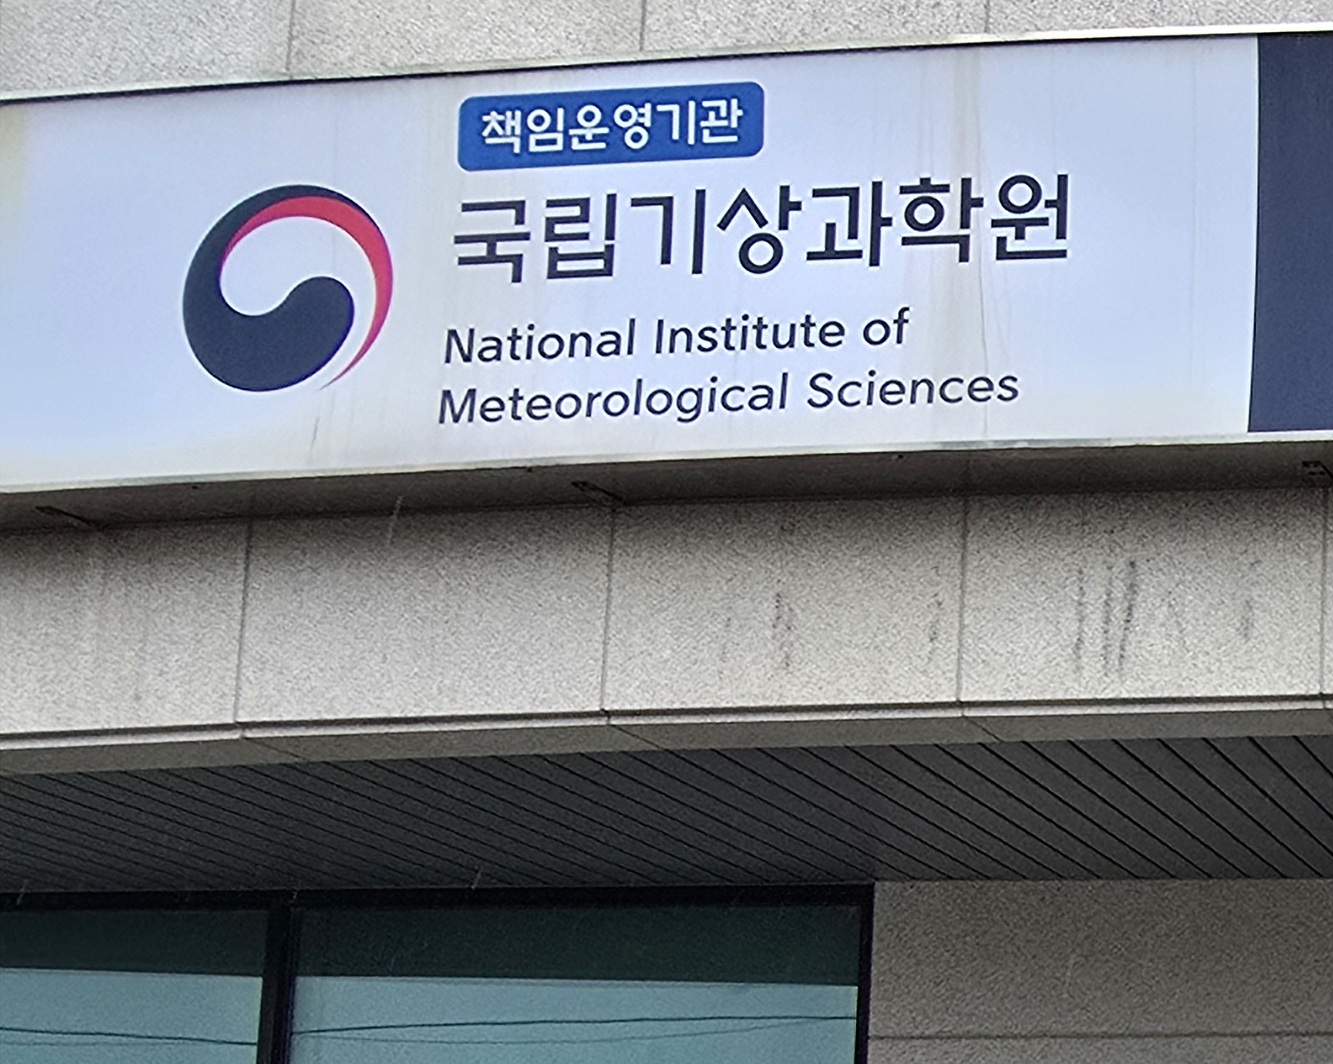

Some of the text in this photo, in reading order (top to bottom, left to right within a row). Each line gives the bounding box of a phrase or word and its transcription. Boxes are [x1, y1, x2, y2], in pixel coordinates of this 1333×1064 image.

[482, 97, 743, 154] 책임운영기관
[453, 173, 1070, 284] 국립기상과학원
[444, 306, 910, 364] National Institute of
[438, 369, 1019, 425] Meteorological Sciences
